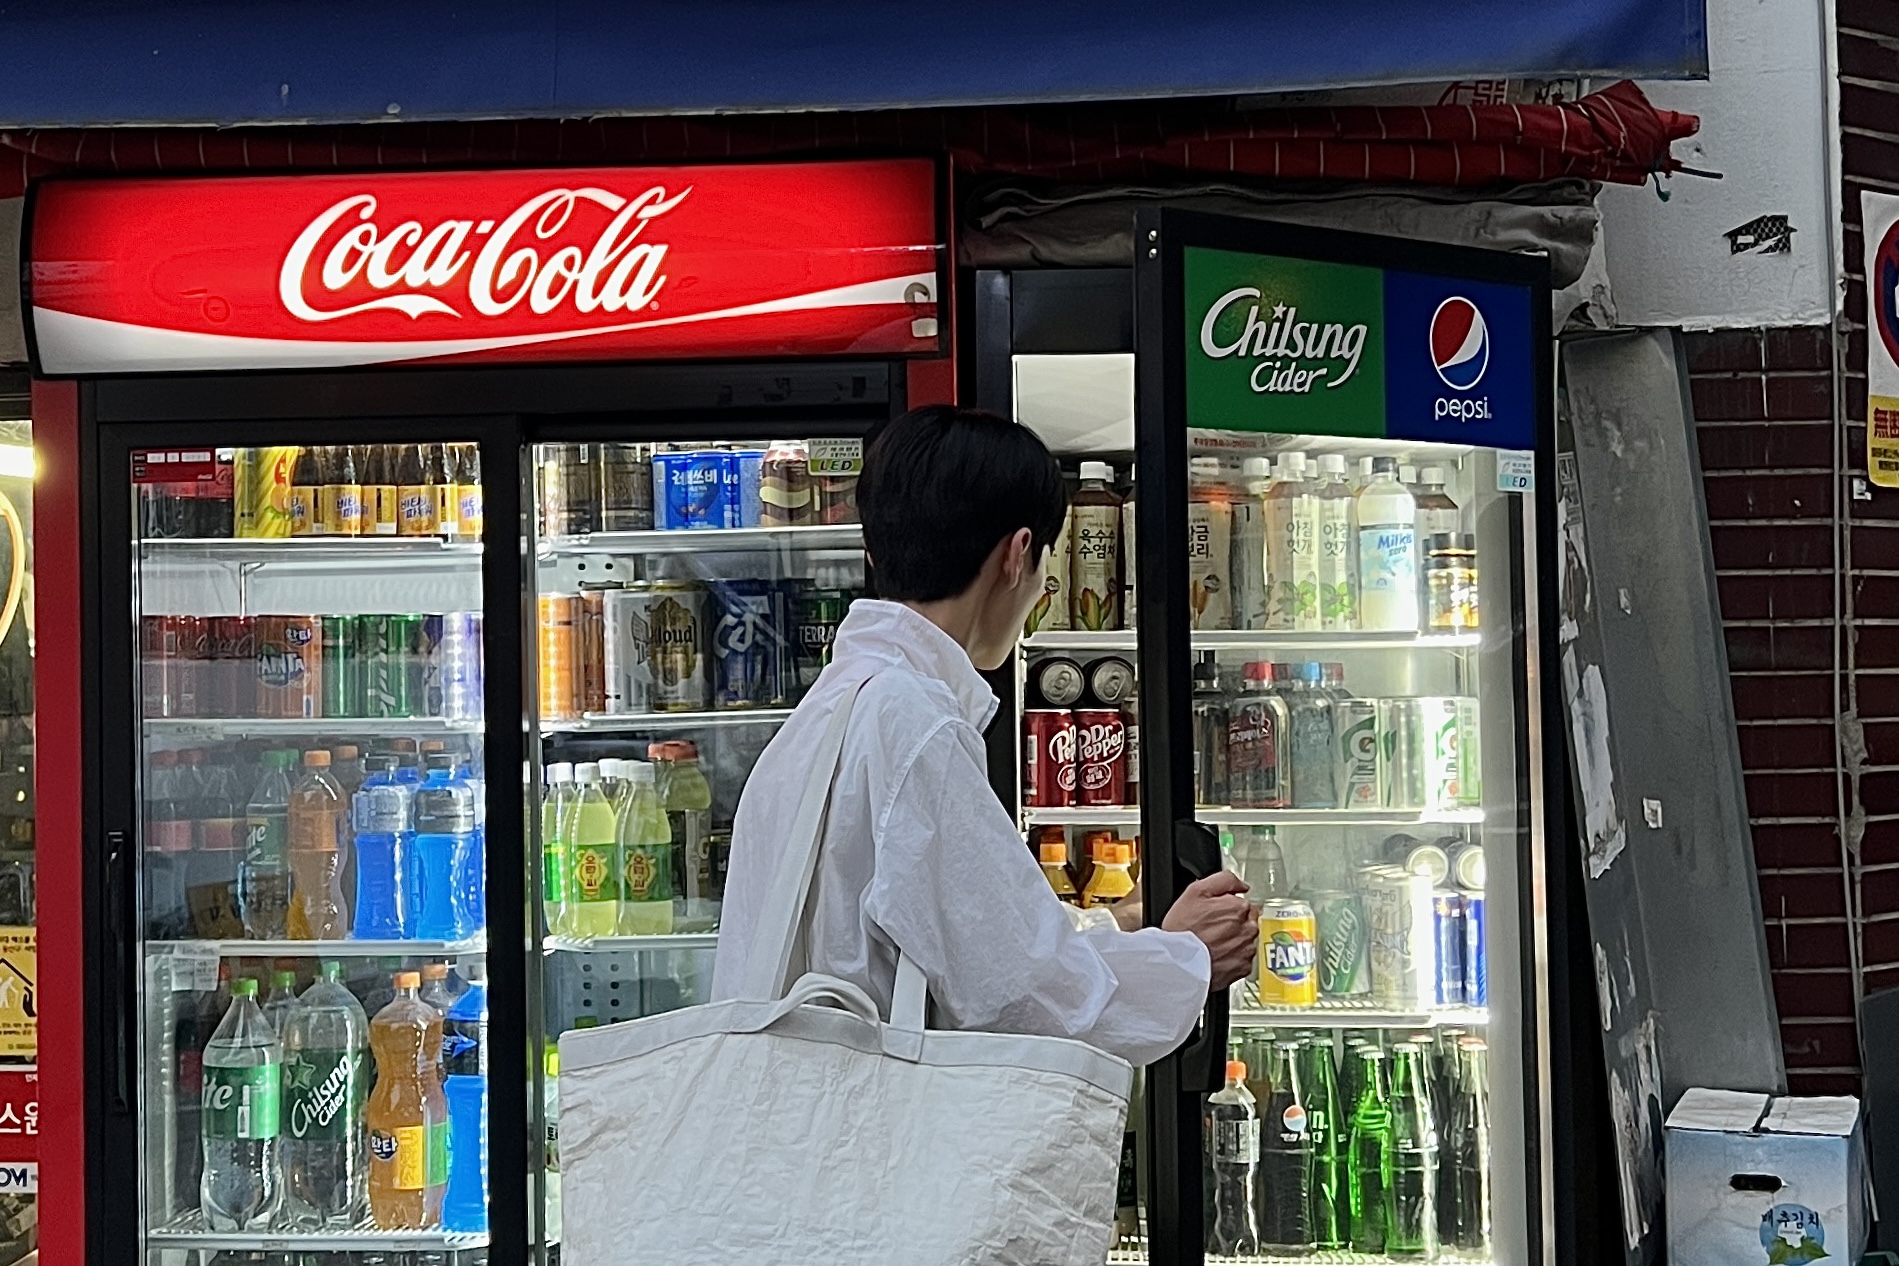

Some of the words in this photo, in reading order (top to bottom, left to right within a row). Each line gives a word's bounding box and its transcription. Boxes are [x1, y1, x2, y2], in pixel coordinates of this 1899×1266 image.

[277, 183, 695, 322] Coca-Cola
[1200, 287, 1368, 388] Chilsung
[1251, 362, 1328, 393] Cider
[1434, 396, 1489, 423] pepsi
[820, 460, 852, 471] LED
[1079, 728, 1123, 761] Pepper
[1090, 724, 1113, 743] Dr
[291, 1055, 351, 1138] Chilsung
[318, 1084, 347, 1127] Cider
[1761, 1208, 1820, 1230] 배추김치
